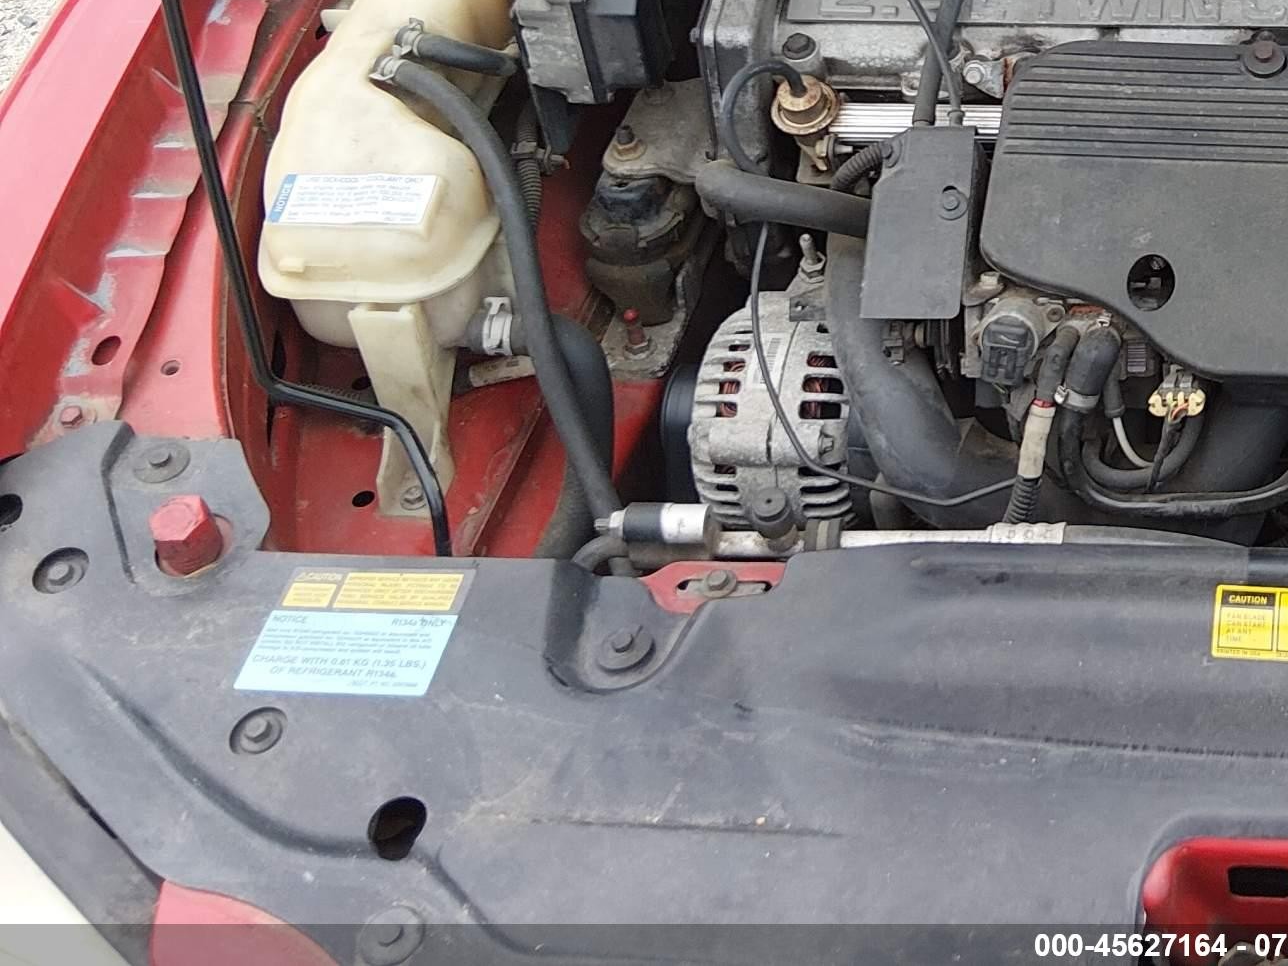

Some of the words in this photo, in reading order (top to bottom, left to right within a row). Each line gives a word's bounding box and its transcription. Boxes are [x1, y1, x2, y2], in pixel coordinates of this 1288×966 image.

[274, 183, 292, 212] NOTICE
[1228, 594, 1268, 605] CAUTION
[272, 614, 308, 625] NOTICE
[252, 654, 298, 665] CHARGE
[302, 657, 329, 666] WITH
[352, 658, 369, 668] KG
[269, 666, 286, 675] OF
[287, 666, 365, 679] REFRIGERANT
